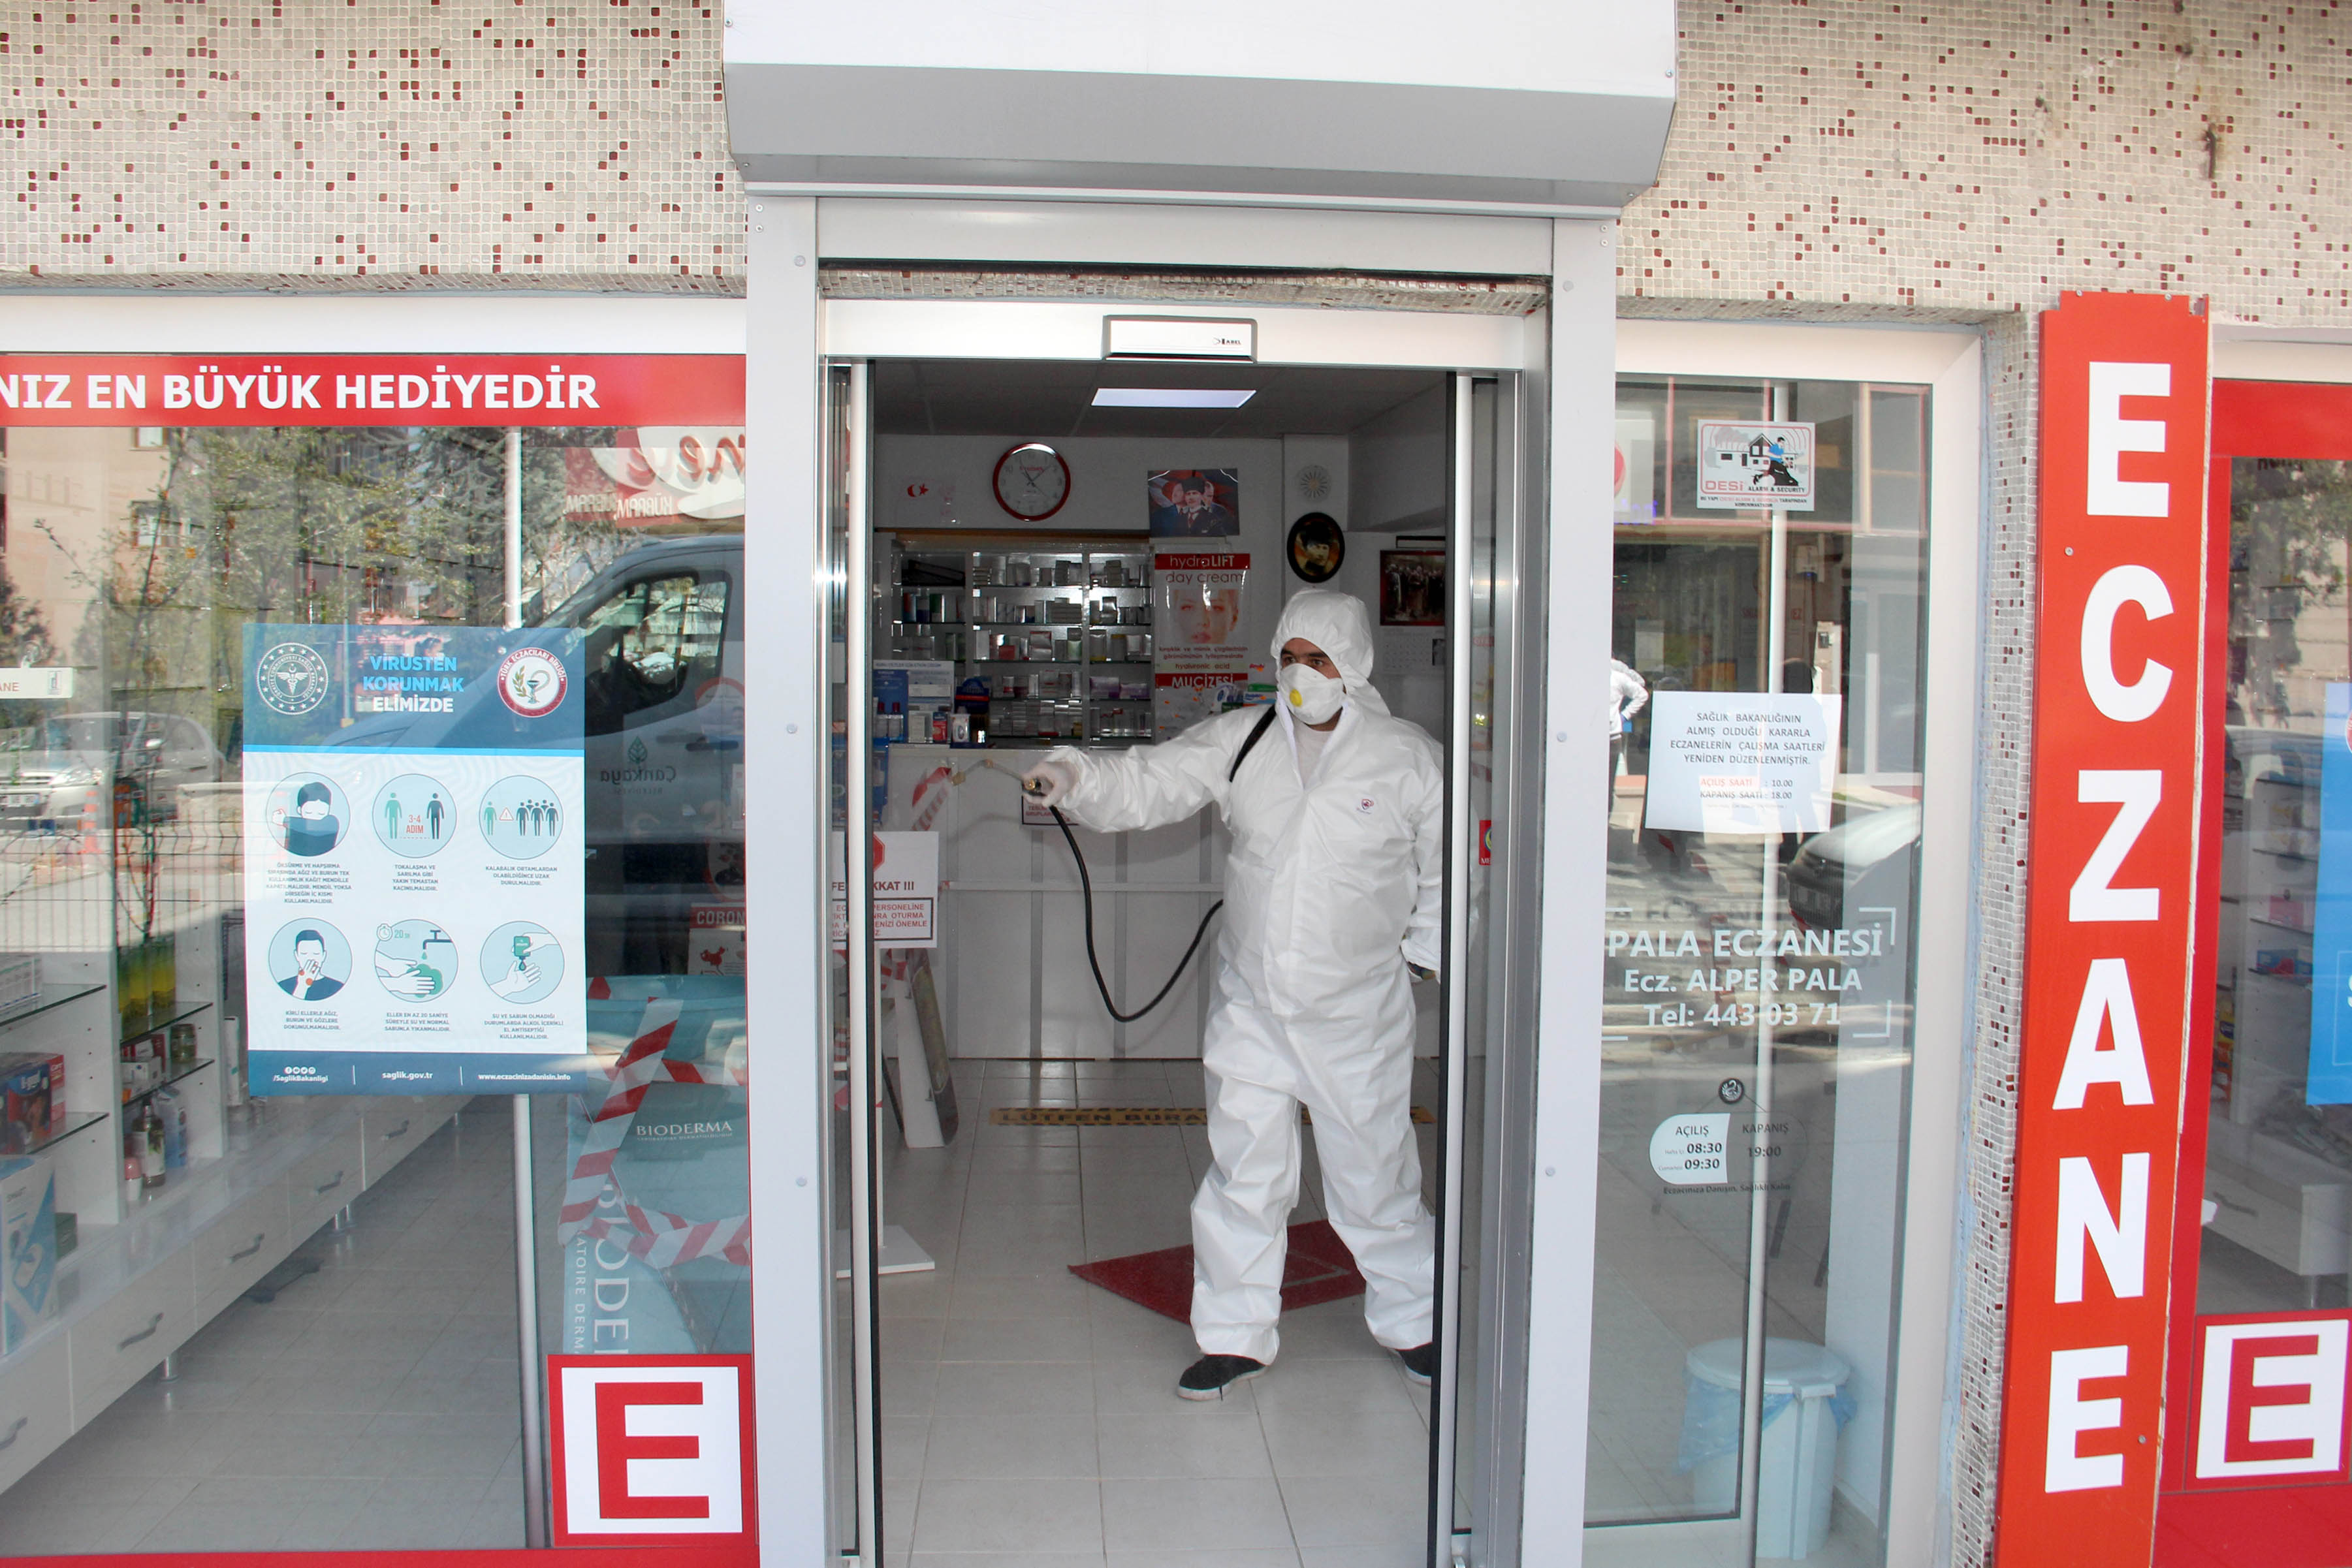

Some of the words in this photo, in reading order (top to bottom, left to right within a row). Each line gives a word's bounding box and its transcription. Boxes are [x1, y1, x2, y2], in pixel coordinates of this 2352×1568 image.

[87, 374, 146, 409] EN
[163, 365, 322, 409] BÜYÜK
[336, 364, 601, 409] HEDİYEDİR
[1169, 555, 1235, 570] hydraLIFT
[1165, 571, 1192, 585] day
[1197, 572, 1244, 584] cream
[370, 653, 457, 672] VİRÜSTEN
[500, 660, 513, 678] TÜRK
[511, 649, 550, 663] ECZACILARI
[362, 676, 465, 693] KORUNMAK
[373, 694, 454, 713] ELİMİZDE
[1697, 711, 1729, 722] SAĞLIK
[1736, 712, 1801, 723] BAKANLIĞININ
[1687, 727, 1715, 738] ALMIŞ
[1722, 726, 1762, 738] OLDUĞU
[1768, 728, 1811, 738] KARARLA
[1670, 738, 1731, 750] ECZANELERİN
[1739, 741, 1779, 752] ÇALIŞMA
[1783, 740, 1825, 751] SAATLERİ
[1683, 753, 1724, 764] YENİDEN
[1729, 754, 1811, 766] DÜZENLENMİŞTİR.
[1772, 779, 1793, 787] 10.00
[1772, 791, 1792, 800] 18.00
[408, 814, 421, 824] 3-4
[405, 824, 424, 834] ADIM
[896, 919, 928, 928] ÖNEMLE
[2045, 361, 2174, 1494] ECZANE
[394, 929, 404, 939] 20
[1608, 930, 1701, 958] PALA
[1713, 923, 1882, 957] ECZANESİ
[1625, 969, 1677, 992] Ecz.
[1686, 969, 1779, 992] ALPER
[1788, 967, 1863, 991] PALA
[1643, 1003, 1694, 1027] Tel:
[1703, 1003, 1755, 1026] 443
[1765, 1003, 1799, 1026] 03
[1809, 1002, 1841, 1026] 71
[273, 1074, 328, 1083] /SaglikBakanligi
[381, 1071, 433, 1080] saglik.gov.tr
[1125, 1114, 1205, 1122] BURA
[637, 1121, 732, 1136] BIODERMA
[1675, 1125, 1709, 1138] AÇILIŞ
[1742, 1122, 1788, 1135] KAPANIŞ
[1687, 1142, 1723, 1154] 08:30
[1747, 1145, 1782, 1158] 19:00
[1685, 1158, 1720, 1170] 09:30
[2224, 1334, 2319, 1464] E
[595, 1381, 710, 1519] E
